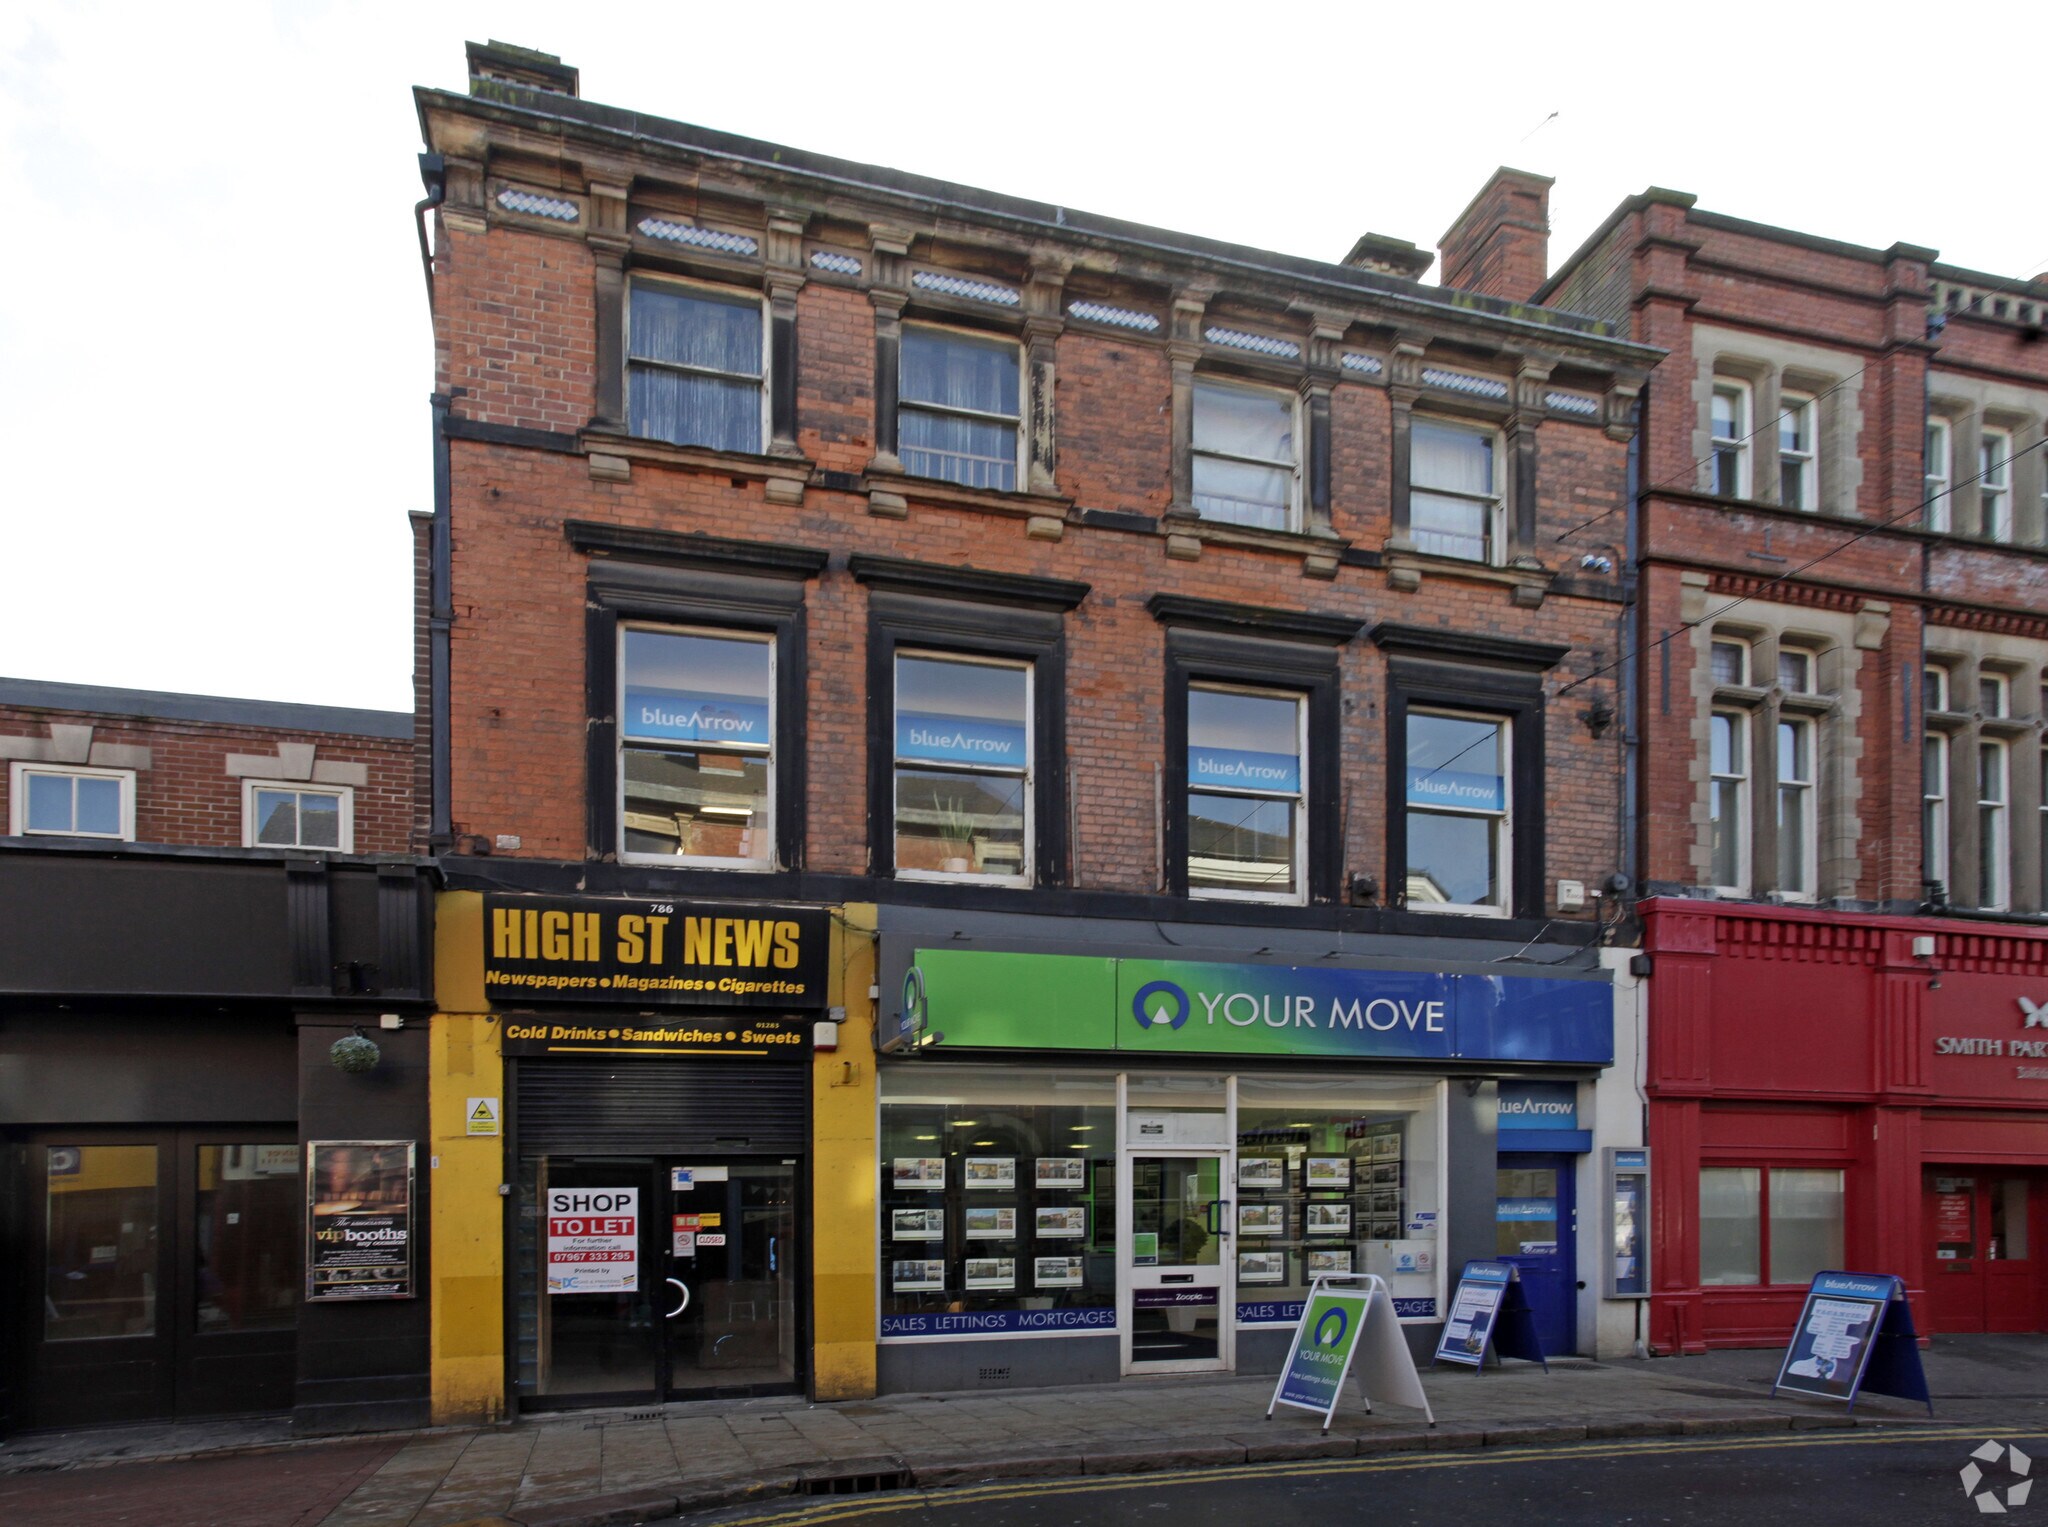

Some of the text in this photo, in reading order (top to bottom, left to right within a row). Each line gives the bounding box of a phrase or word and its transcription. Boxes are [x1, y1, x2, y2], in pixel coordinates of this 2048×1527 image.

[641, 707, 754, 732] blueArrow
[910, 729, 1012, 753] blueArrow
[1198, 758, 1288, 780] blueArrow
[1415, 778, 1496, 799] blueArrow
[650, 904, 674, 914] 786
[493, 908, 800, 969] HIGH ST NEWS
[485, 970, 805, 995] Newspapers Magazines Cigarettes
[1197, 992, 1445, 1033] YOUR MOVE
[506, 1025, 801, 1044] Cold Drinks Sandwiches Sweets
[1935, 1036, 2048, 1058] SMITH PAR
[1496, 1097, 1574, 1115] lueArrow
[553, 1194, 632, 1213] SHOP
[552, 1218, 632, 1235] TO LET
[698, 1235, 724, 1244] CLOSED
[554, 1251, 631, 1262] 07967 333 295
[1824, 1279, 1879, 1292] blueArrow
[882, 1310, 1116, 1332] SALES LETTINGS MORTGAGES
[1237, 1305, 1276, 1318] SALES
[1299, 1348, 1345, 1366] YOUR MOVE
